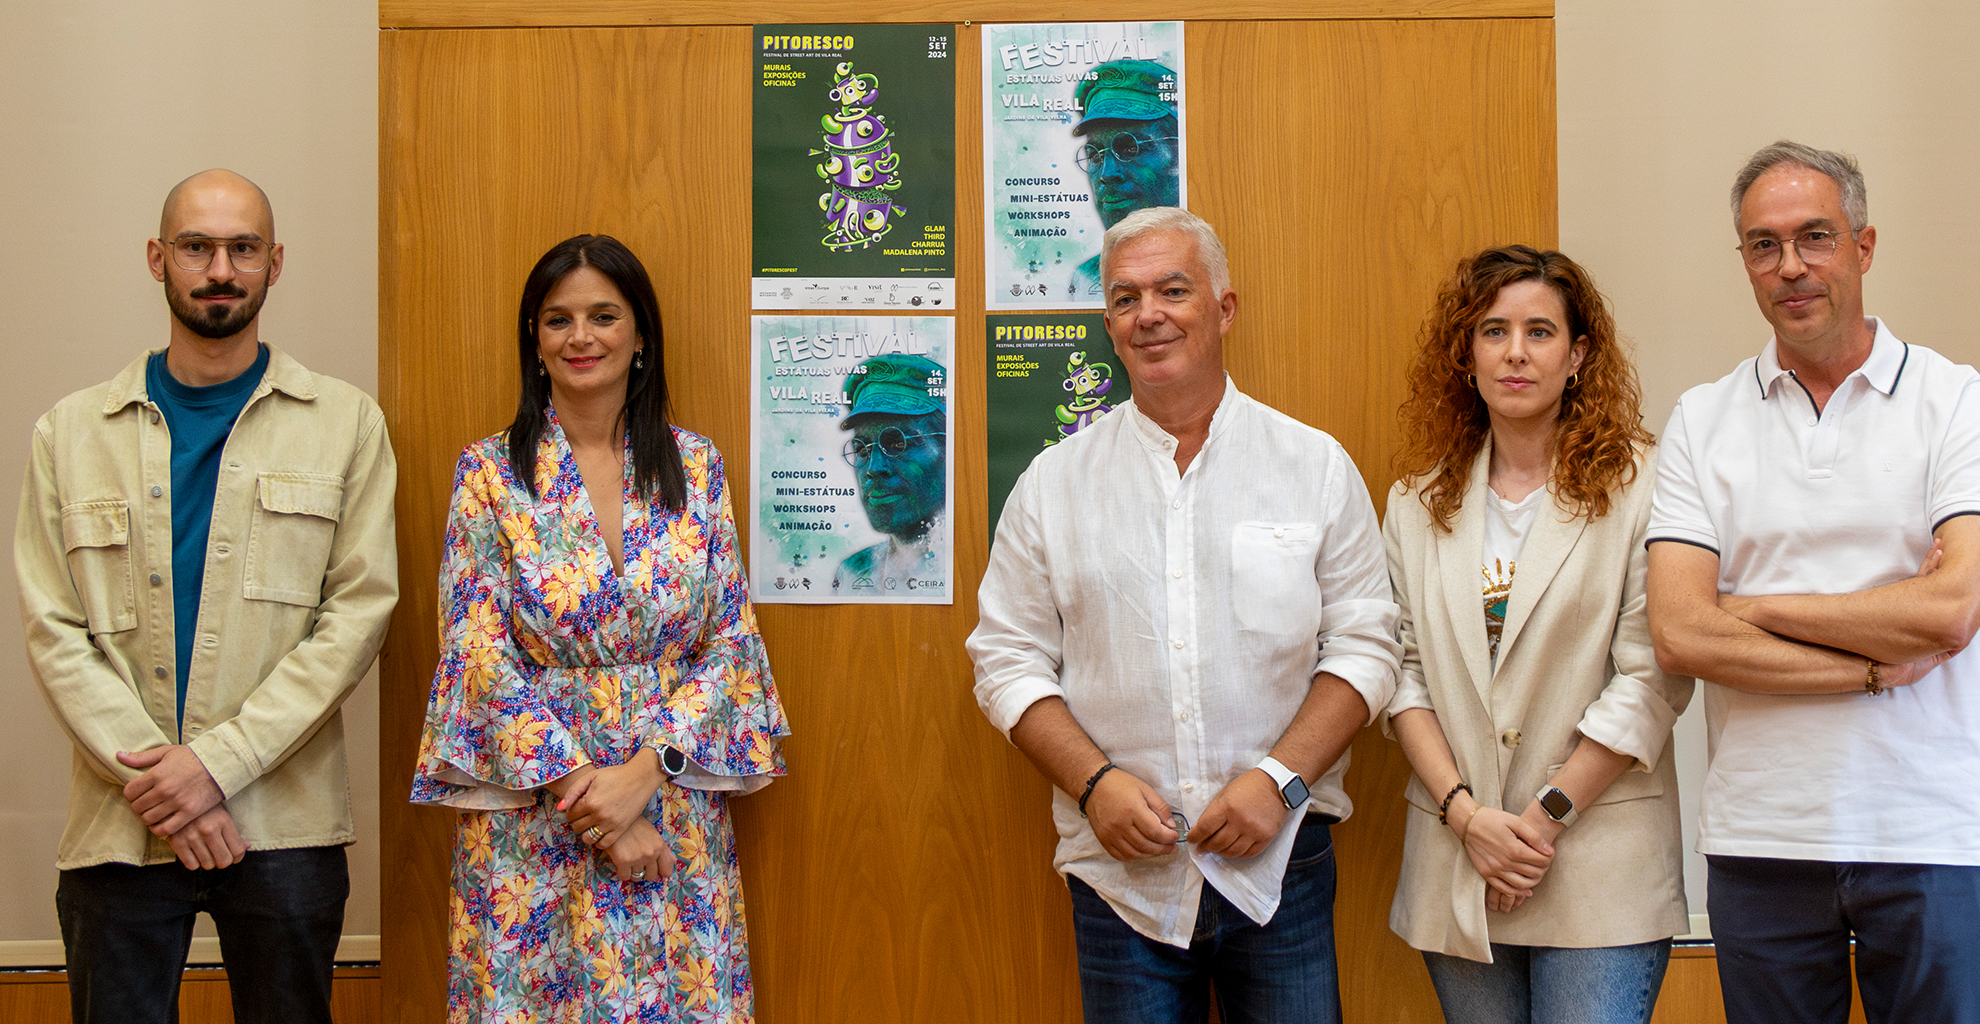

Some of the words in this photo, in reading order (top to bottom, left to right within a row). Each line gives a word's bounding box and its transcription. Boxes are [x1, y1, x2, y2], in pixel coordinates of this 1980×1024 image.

[763, 35, 854, 50] PITORESCO
[929, 42, 947, 50] SET
[999, 37, 1158, 71] FESTIVAL
[763, 71, 806, 80] EXPOSIÇÕES
[1006, 71, 1062, 84] ESTÁTUAS
[1065, 71, 1099, 82] VIVAS
[1158, 82, 1174, 90] SET
[1158, 92, 1178, 101] 15H
[1001, 94, 1040, 108] VILA
[1043, 98, 1084, 112] REAL
[1005, 177, 1061, 186] CONCURSO
[1010, 192, 1089, 203] MINI-ESTÁTUAS
[1008, 211, 1071, 220] WORKSHOPS
[1014, 226, 1067, 238] ANIMAÇÃO
[995, 325, 1087, 340] PITORESCO
[768, 331, 927, 363] FESTIVAL
[775, 364, 831, 376] ESTÁTUAS
[834, 365, 868, 375] VIVAS
[996, 361, 1039, 370] EXPOSIÇÕES
[931, 369, 943, 377] 14.
[927, 377, 943, 385] SET
[770, 386, 808, 400] VILA
[811, 391, 852, 405] REAL
[927, 387, 947, 397] 15H
[771, 470, 827, 479] CONCURSO
[776, 486, 855, 496] MINI-ESTÁTUAS
[773, 504, 836, 513] WORKSHOPS
[779, 520, 832, 531] ANIMAÇÃO
